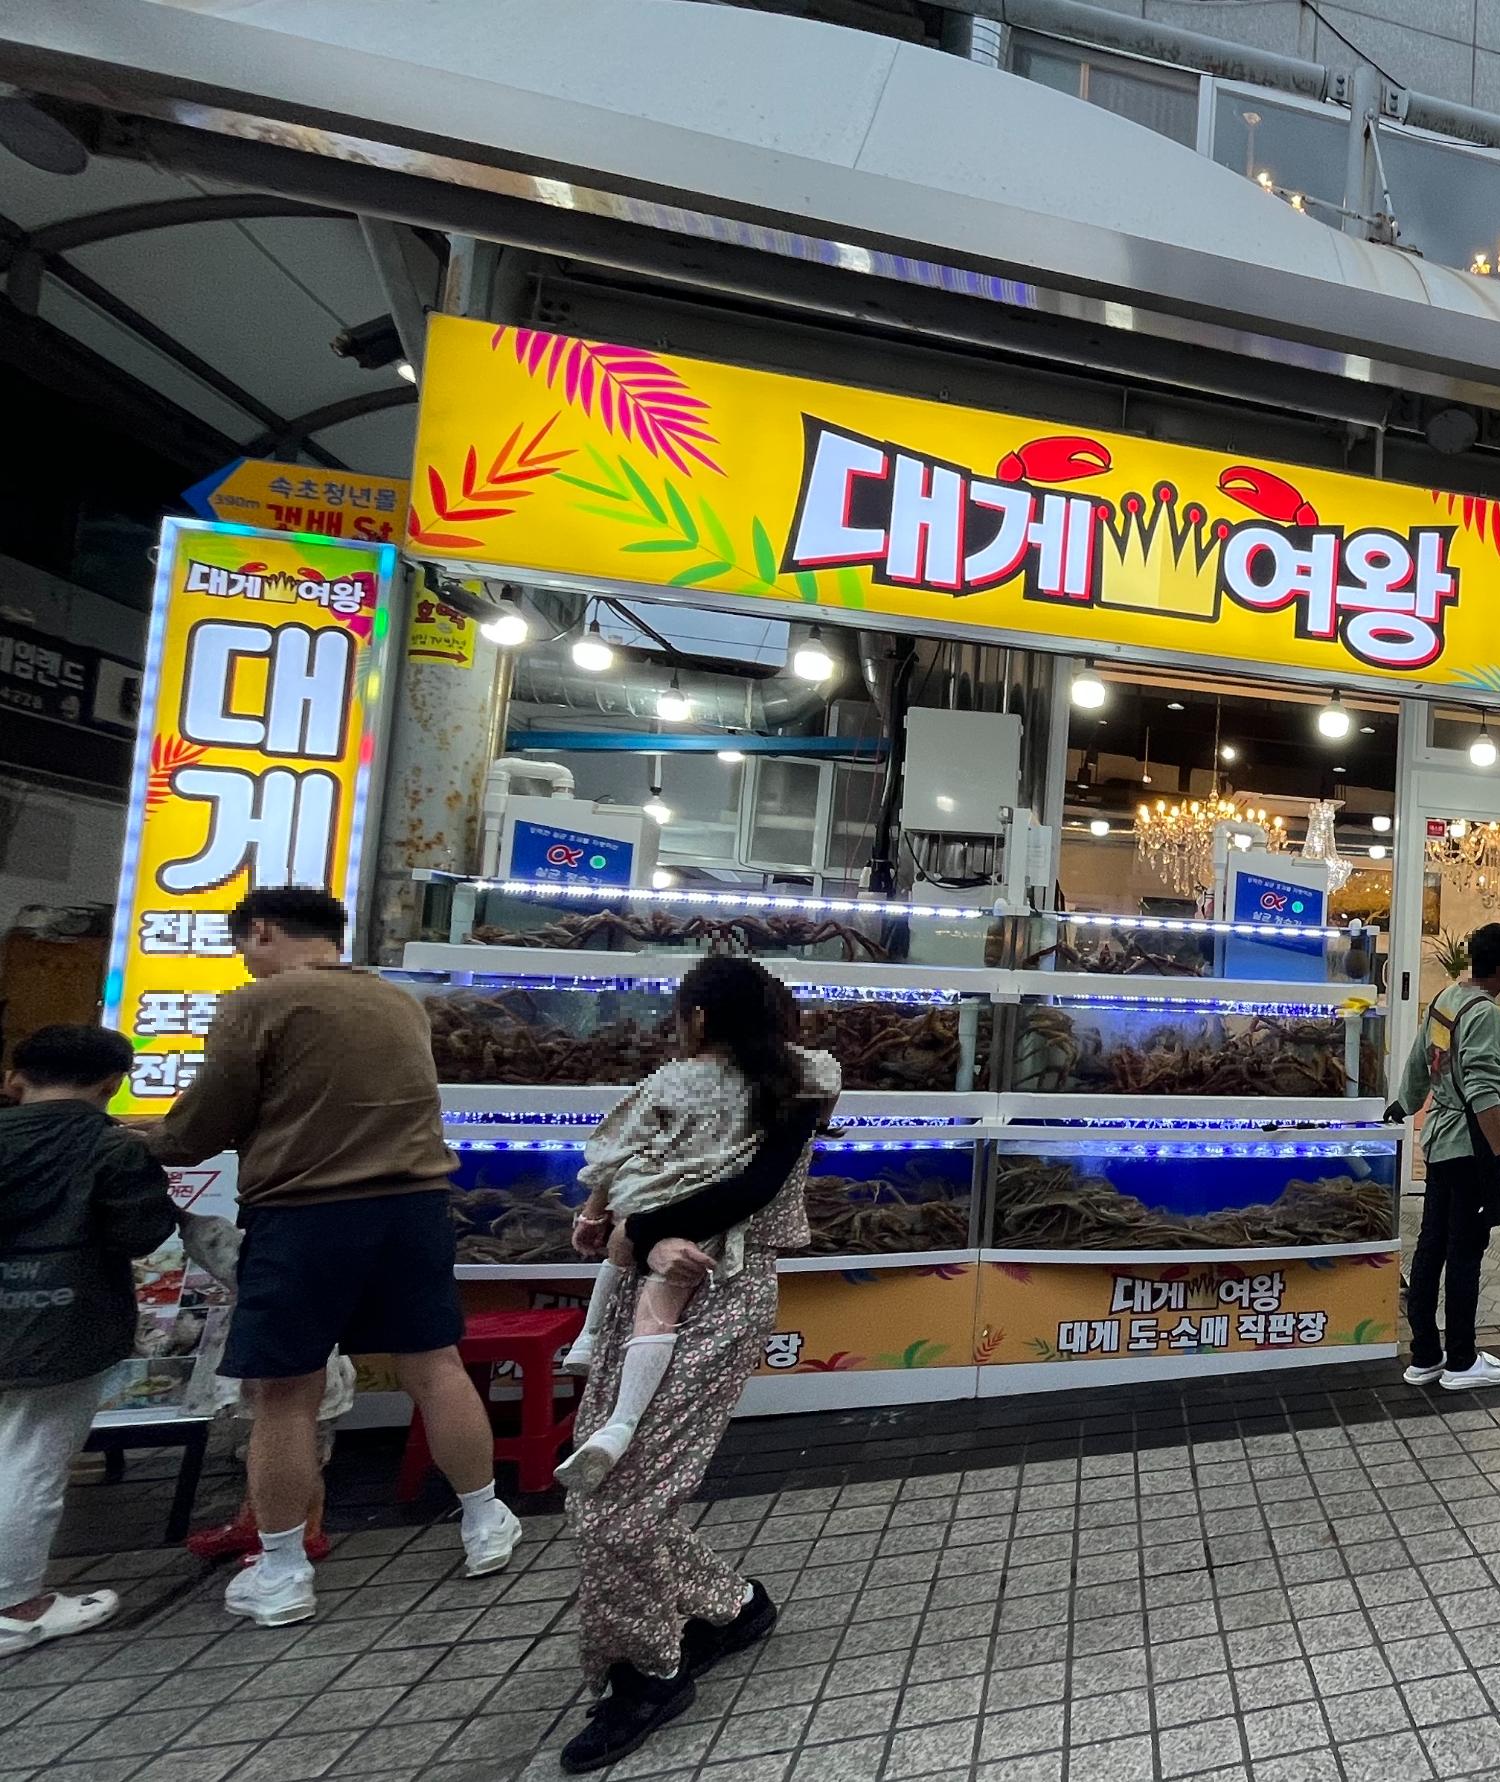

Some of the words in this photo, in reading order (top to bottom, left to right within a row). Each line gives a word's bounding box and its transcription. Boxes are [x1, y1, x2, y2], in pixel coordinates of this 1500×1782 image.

[267, 475, 399, 513] 속초청년몰
[783, 415, 1095, 606] 대게
[1223, 524, 1457, 668] 여왕
[186, 560, 262, 599] 대게
[297, 580, 366, 614] 여왕
[157, 619, 355, 893] 대게
[1111, 1276, 1186, 1315] 대게
[1218, 1270, 1286, 1313] 여왕
[1057, 1317, 1119, 1354] 대게
[1237, 1312, 1328, 1345] 직판장
